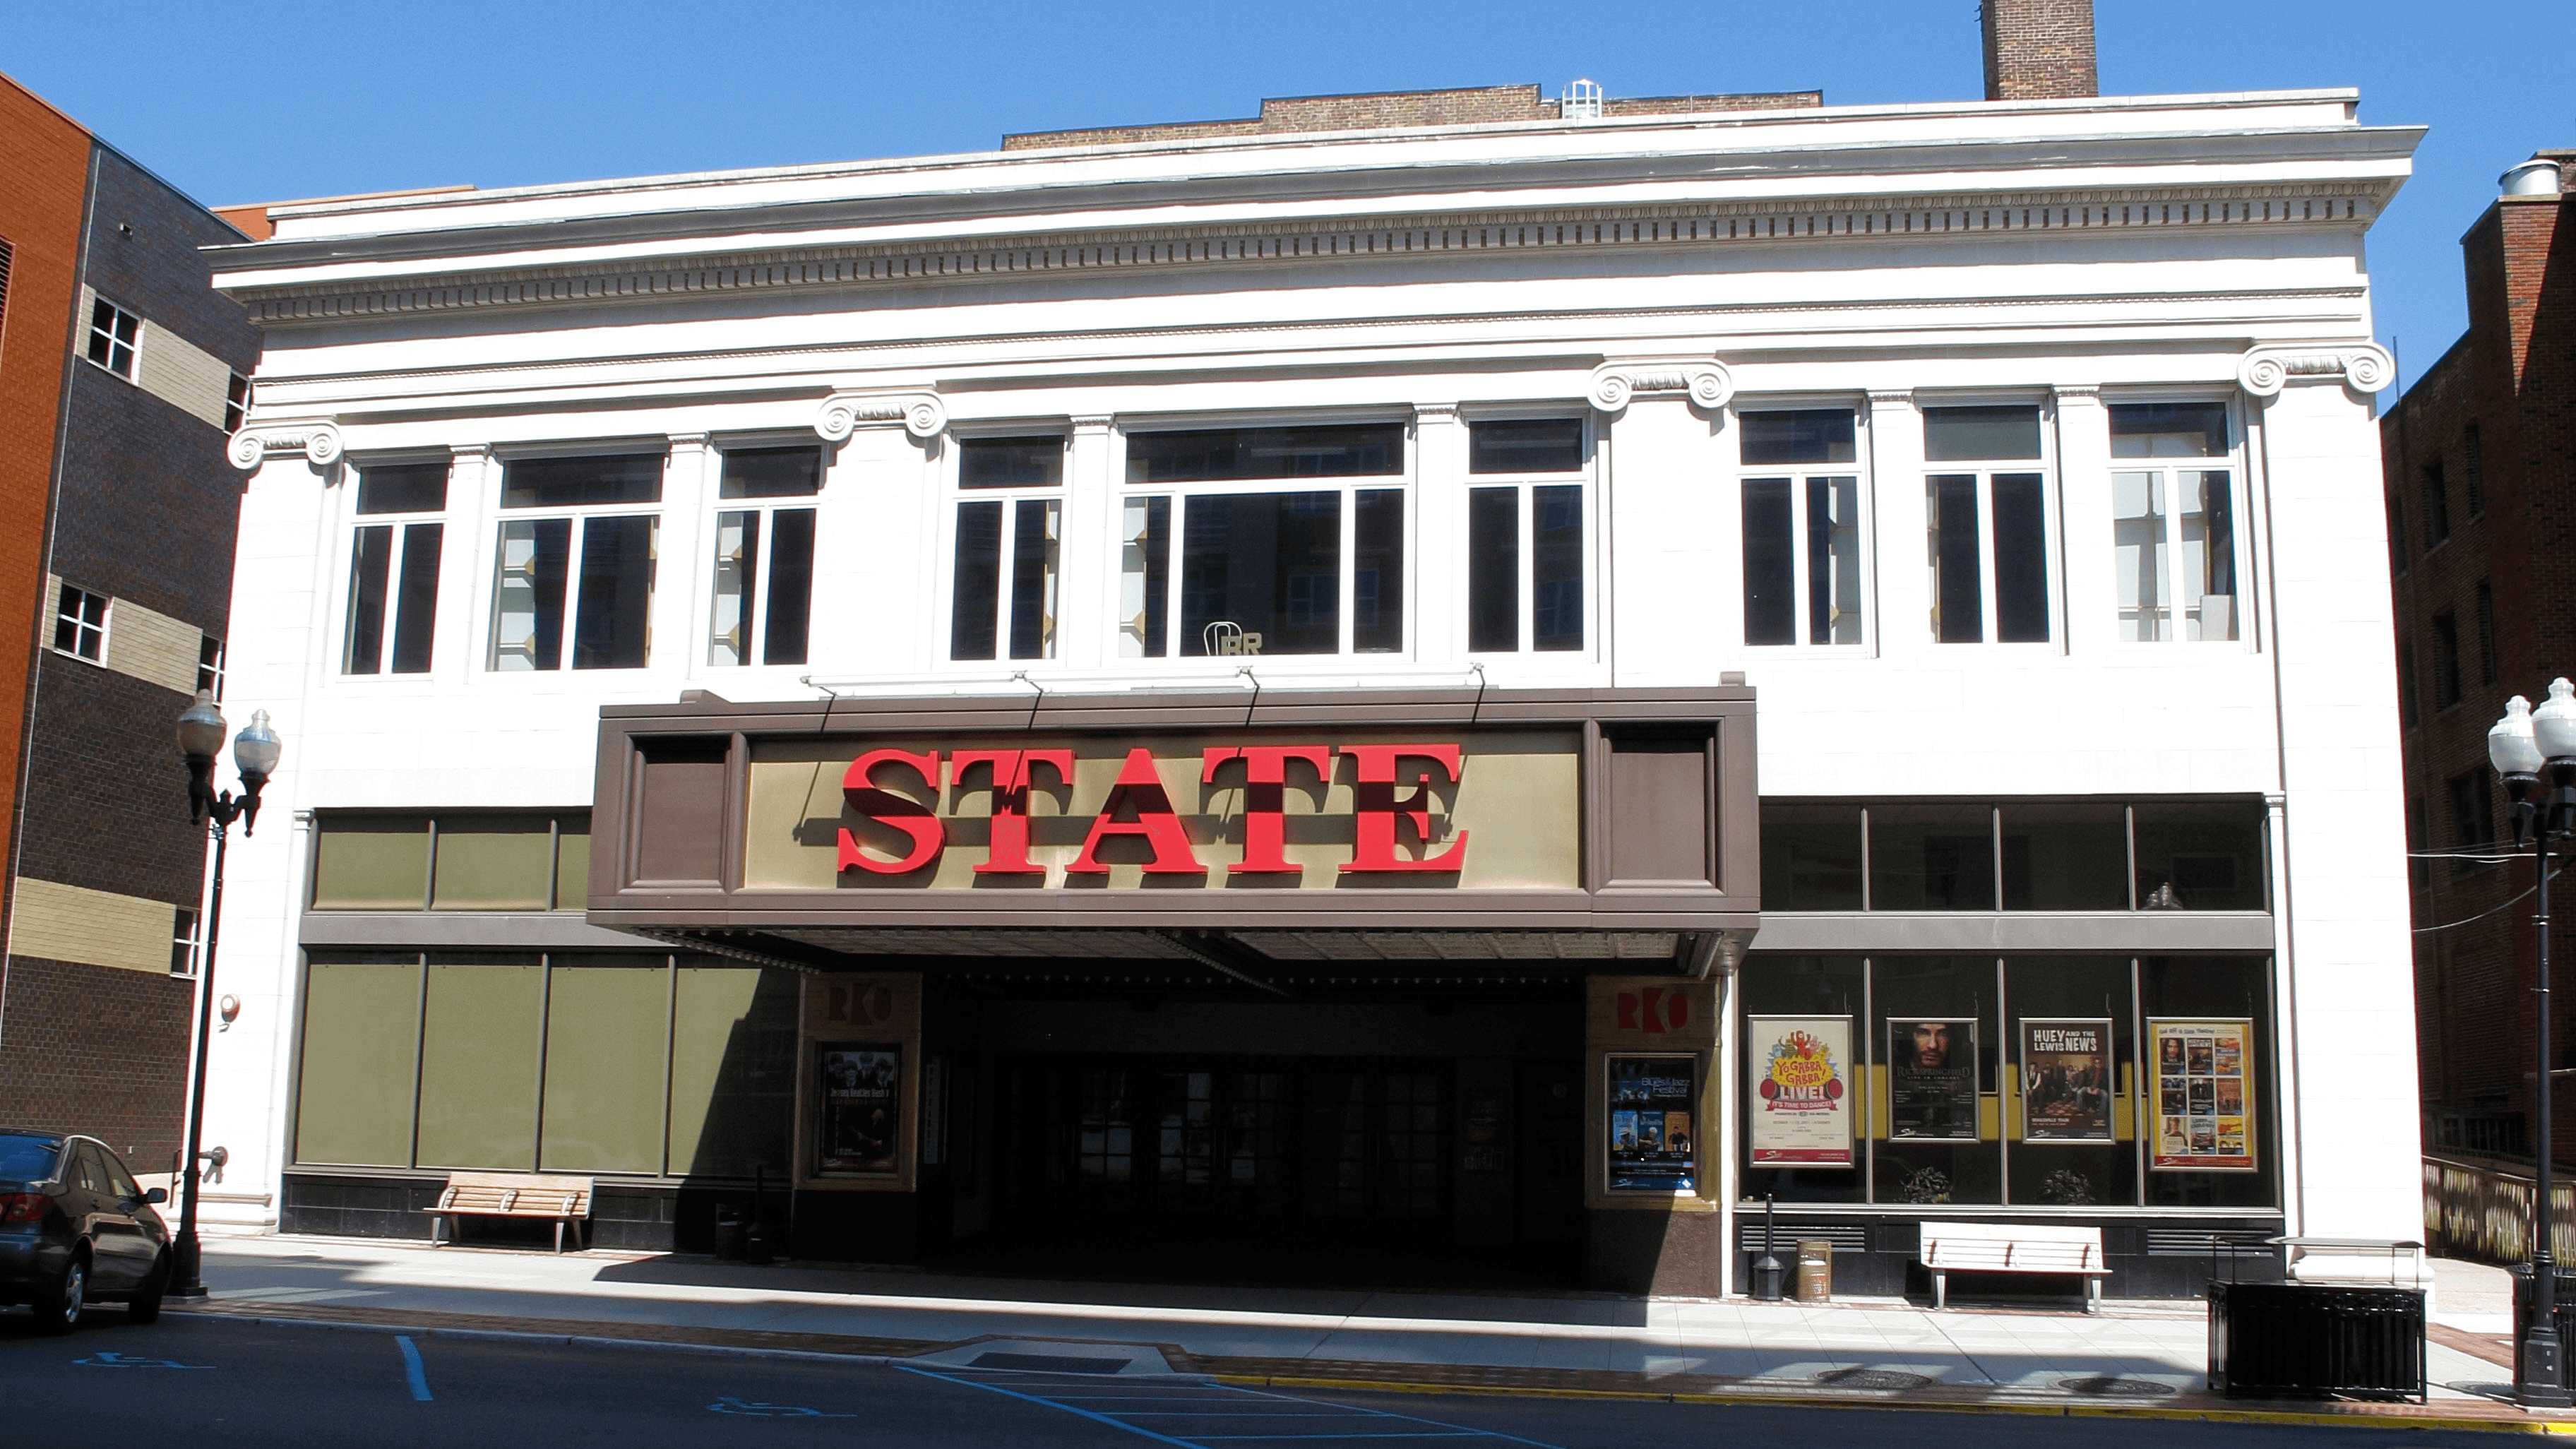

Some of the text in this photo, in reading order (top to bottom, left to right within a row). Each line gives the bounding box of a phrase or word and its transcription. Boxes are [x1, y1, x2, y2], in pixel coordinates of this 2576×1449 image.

[837, 744, 1469, 875] STATE
[829, 982, 892, 1025] RKO
[1618, 988, 1688, 1033] RKO
[2034, 1030, 2065, 1042] HUEY
[2034, 1037, 2097, 1051] LEWIS NEWS
[1790, 1061, 1823, 1074] GABBA
[1641, 1077, 1665, 1086] Blues
[1671, 1078, 1690, 1086] Jazz
[1787, 1068, 1826, 1085] GABBA!
[1652, 1081, 1687, 1094] Festival
[1779, 1085, 1824, 1099] LIVE!
